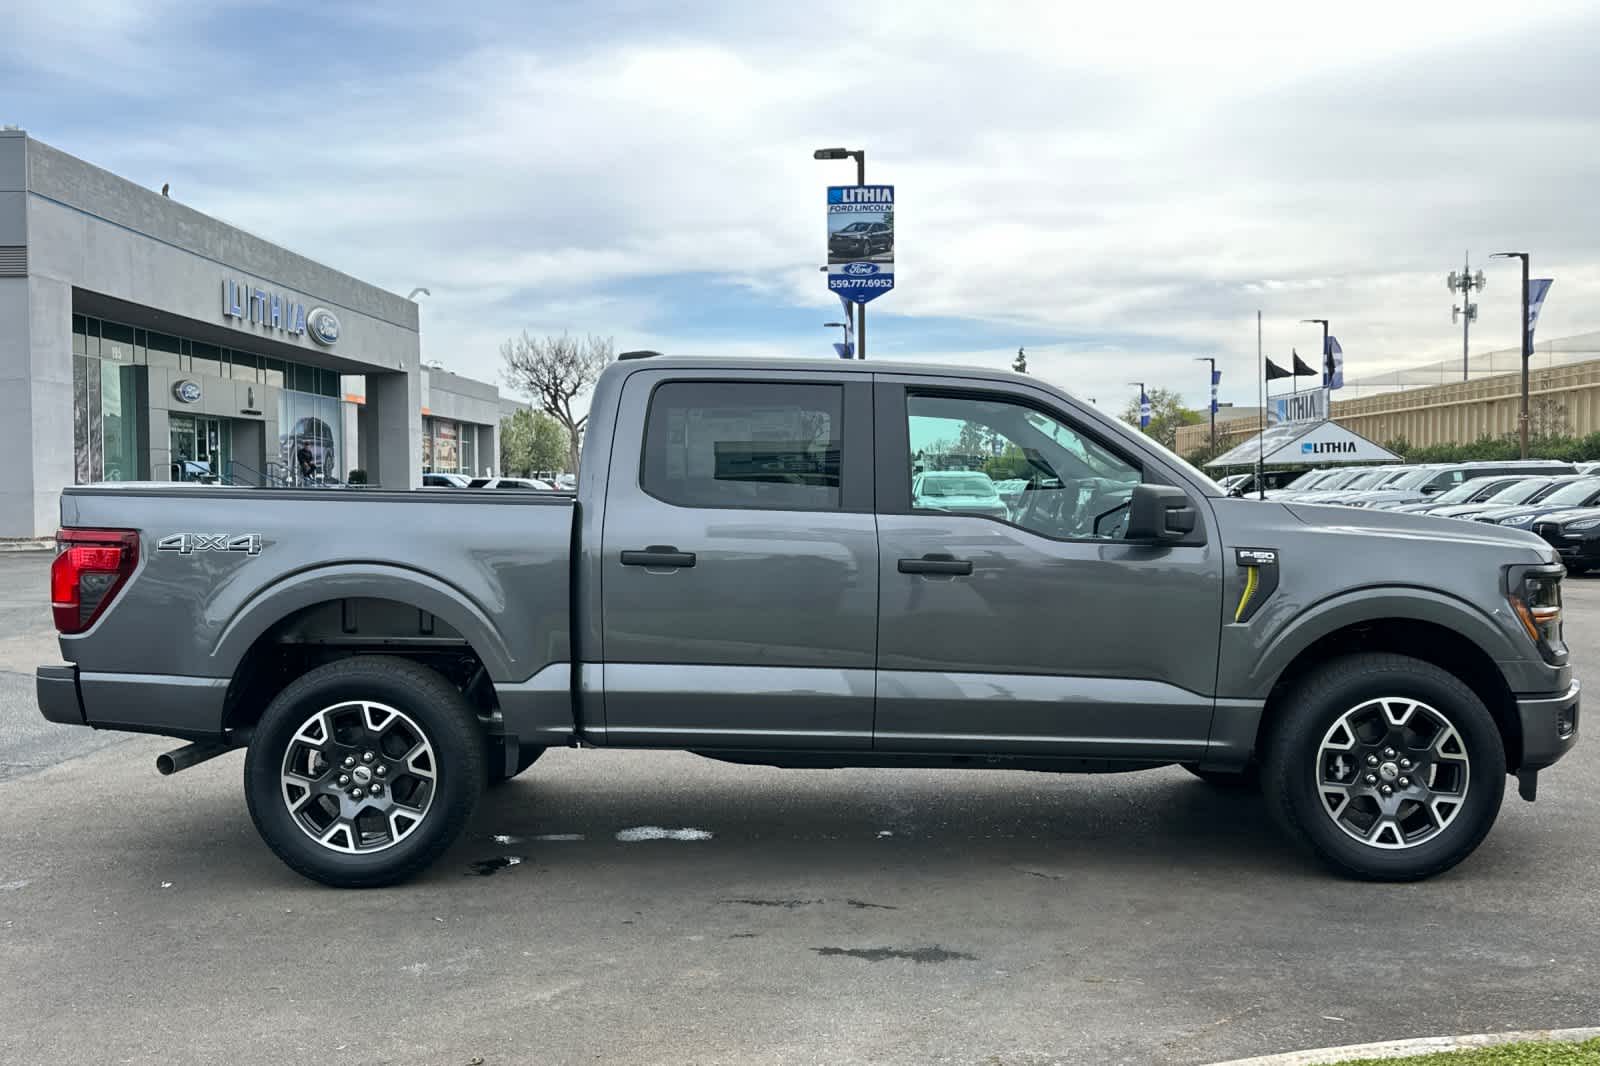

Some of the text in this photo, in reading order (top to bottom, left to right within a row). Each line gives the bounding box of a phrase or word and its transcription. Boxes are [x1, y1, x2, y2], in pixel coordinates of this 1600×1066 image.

[842, 188, 892, 202] LITHIA
[849, 264, 873, 274] Ford
[830, 279, 892, 288] 559.777.6952
[222, 279, 304, 336] LITHIA
[1285, 395, 1316, 420] LITHIA
[1313, 441, 1357, 453] LITHIA
